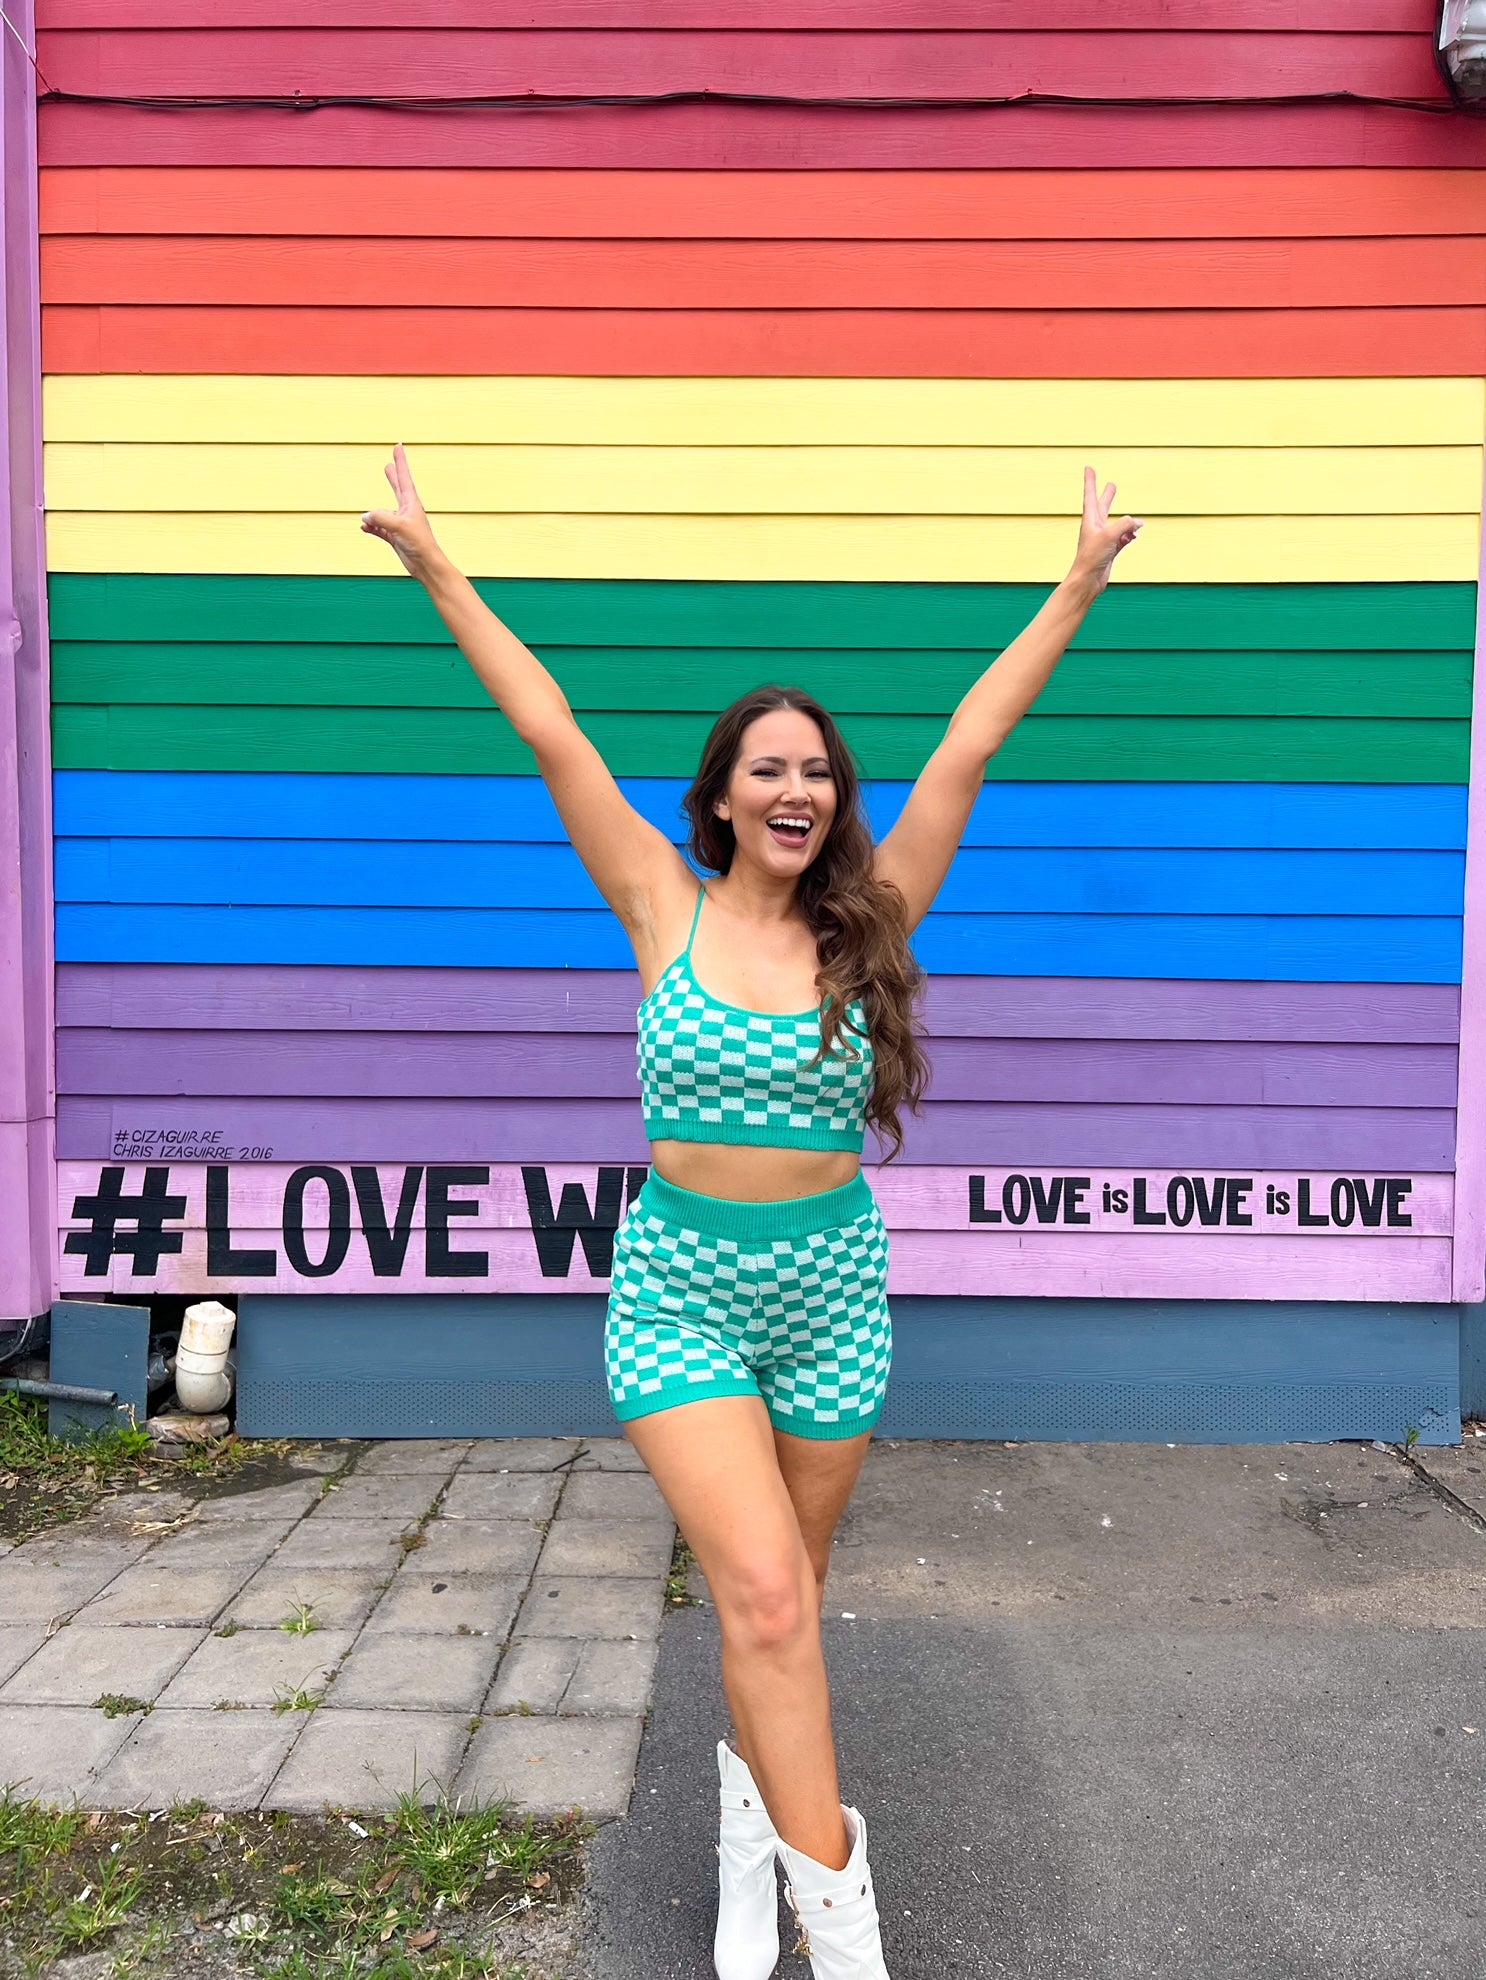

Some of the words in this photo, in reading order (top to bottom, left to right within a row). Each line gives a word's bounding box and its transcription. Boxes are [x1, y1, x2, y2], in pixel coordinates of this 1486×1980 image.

[113, 1144, 154, 1158] CHRIS
[160, 1145, 235, 1160] IZAGUIRRE
[239, 1147, 274, 1160] 2016
[63, 1165, 489, 1278] #LOVE
[968, 1174, 1091, 1225] LOVE
[1102, 1182, 1129, 1214] is
[1133, 1176, 1253, 1227] LOVE
[1266, 1184, 1291, 1215] is
[1297, 1177, 1412, 1227] LOVE
